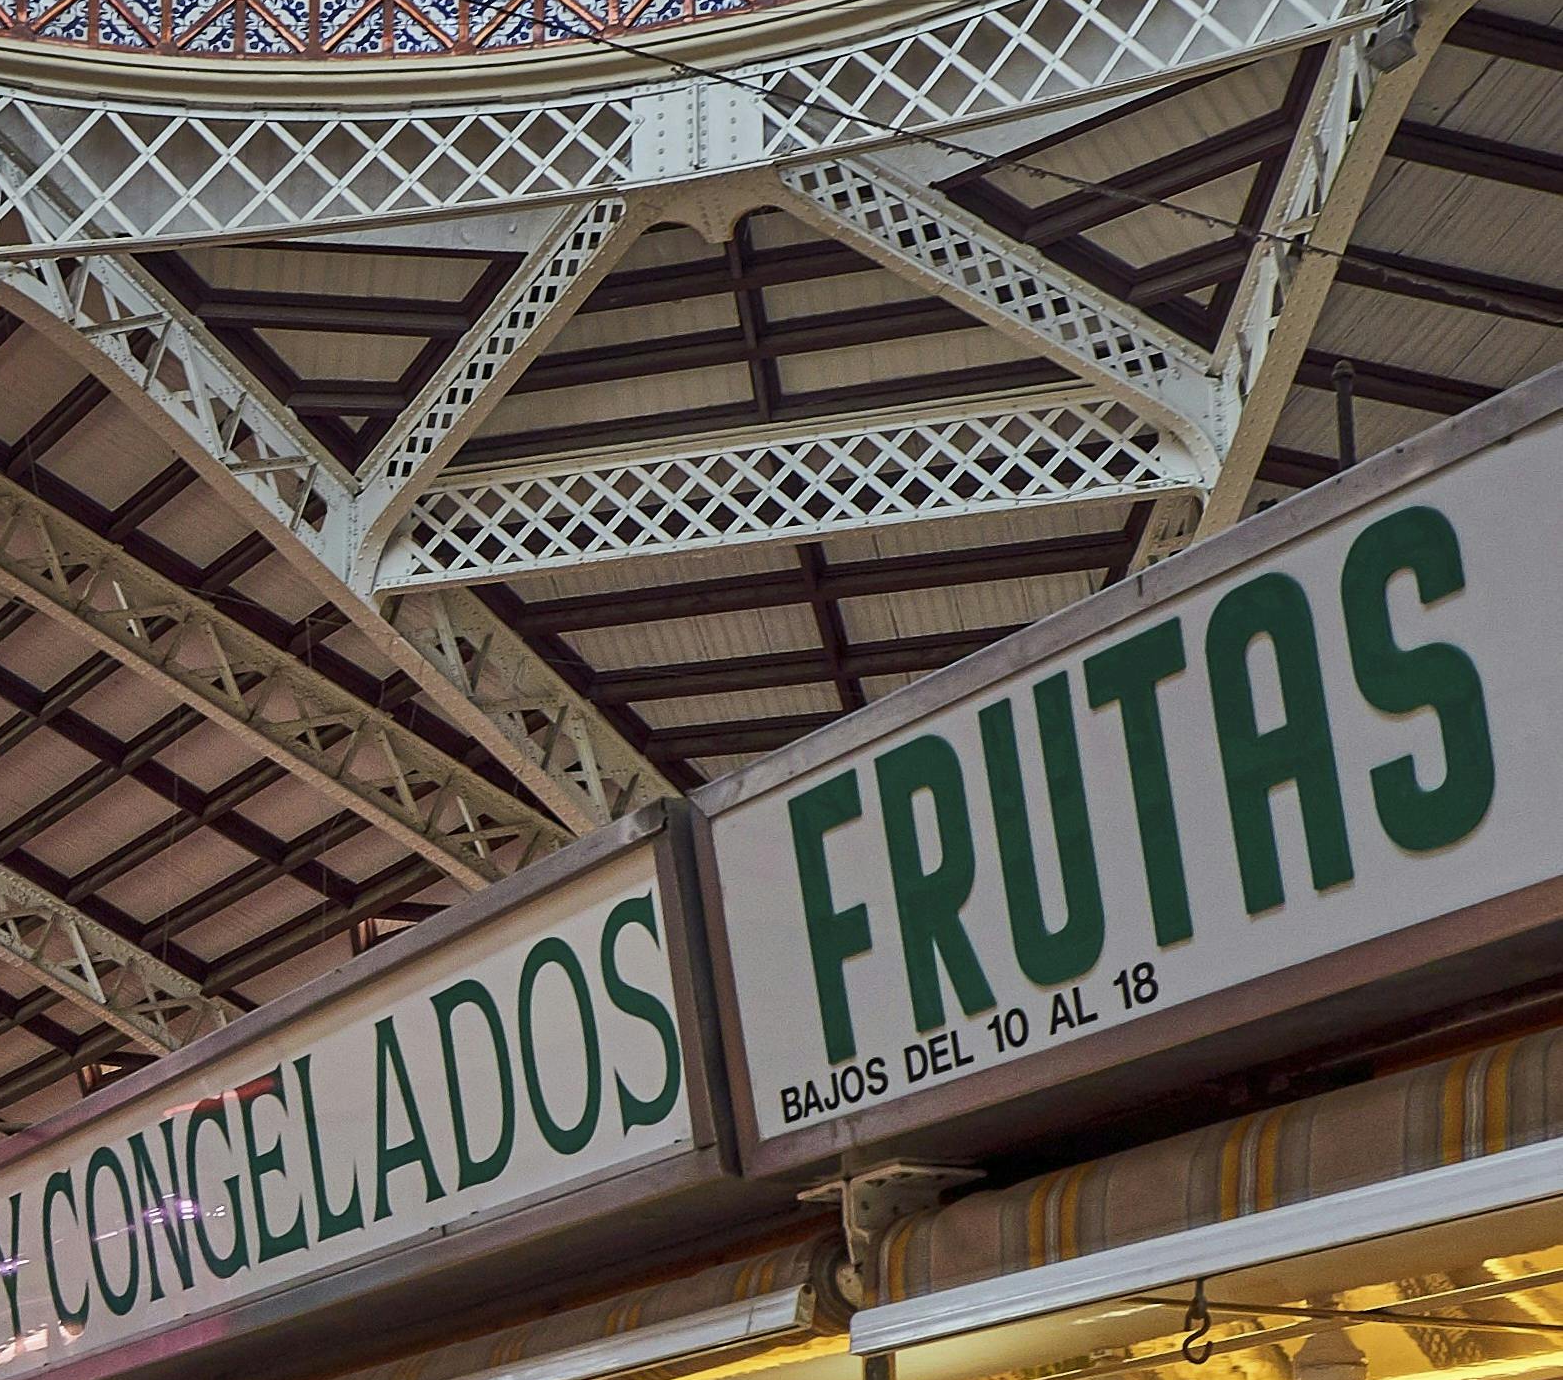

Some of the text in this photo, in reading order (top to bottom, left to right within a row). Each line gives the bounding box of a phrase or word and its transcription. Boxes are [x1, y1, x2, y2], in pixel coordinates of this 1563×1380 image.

[787, 505, 1496, 1066] FRUTAS
[42, 887, 683, 1338] CONGELADOS
[780, 961, 1160, 1124] BAJOS DEL 10 AL 18
